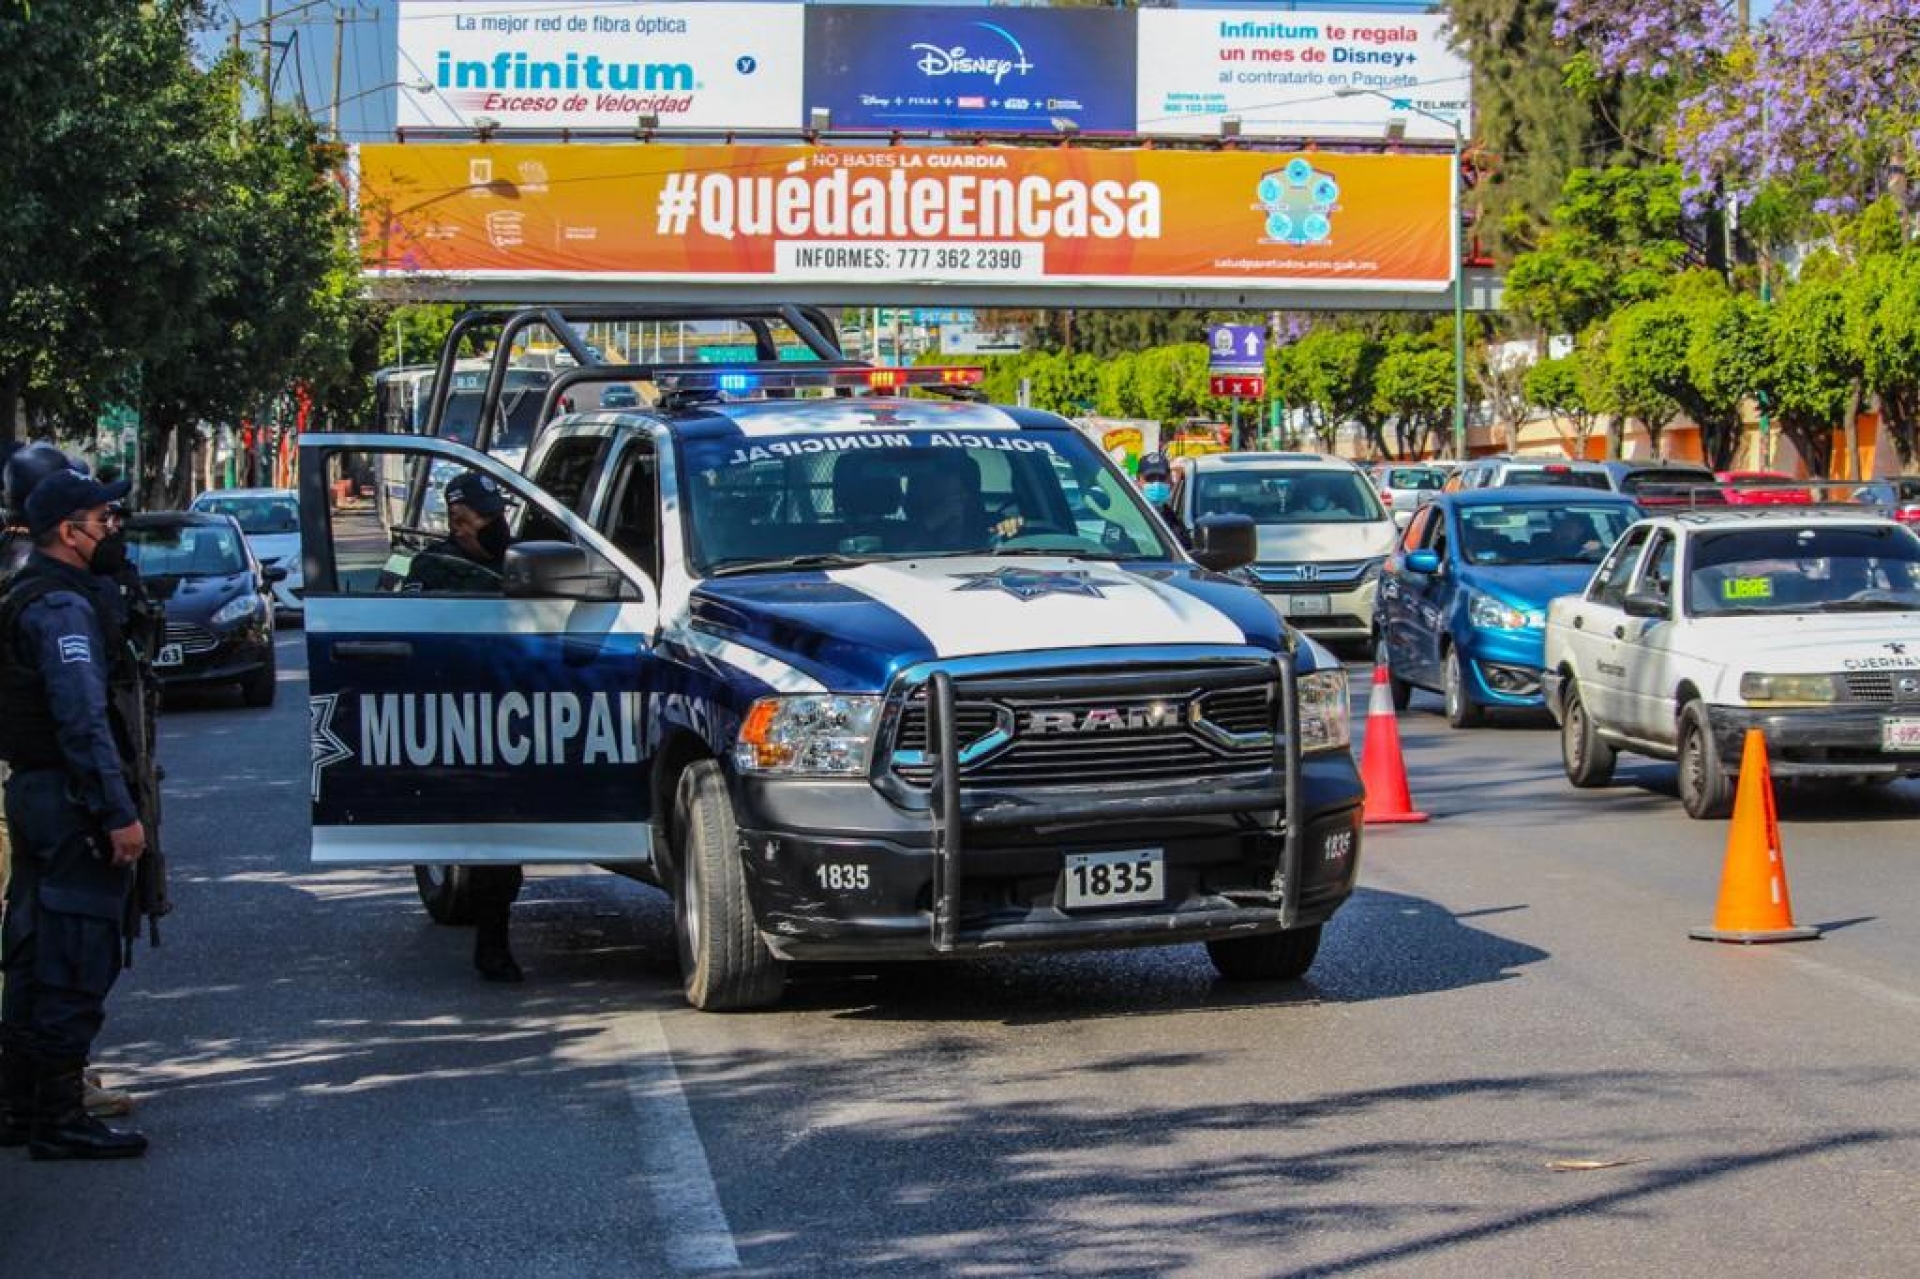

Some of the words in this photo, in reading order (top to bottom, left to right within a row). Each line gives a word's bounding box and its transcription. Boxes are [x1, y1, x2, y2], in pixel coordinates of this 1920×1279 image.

[456, 15, 476, 31] La
[482, 15, 528, 34] mejor
[535, 16, 561, 31] red
[567, 15, 587, 32] de
[593, 16, 630, 32] fibra
[635, 16, 687, 35] óptica
[1220, 21, 1319, 40] Infinitum
[1326, 25, 1346, 40] te
[1352, 26, 1418, 45] regala
[1220, 48, 1245, 61] un
[1252, 48, 1295, 62] mes
[1301, 47, 1327, 62] de
[1333, 47, 1417, 67] Disney+
[437, 50, 694, 91] infinitum
[1219, 70, 1233, 83] al
[1238, 70, 1323, 84] contratarlo
[1328, 74, 1347, 84] en
[1352, 71, 1418, 88] Paquete
[484, 93, 558, 111] Exceso
[563, 94, 588, 112] de
[595, 95, 692, 113] Velocidad
[1416, 100, 1468, 110] TELMEX
[812, 154, 839, 167] NO
[843, 154, 897, 168] BAJES
[900, 154, 923, 168] LA
[927, 155, 1007, 168] GUARDIA
[656, 158, 1161, 240] #QuédateEnCasa
[795, 247, 891, 269] INFORMES:
[897, 248, 931, 269] 777
[936, 248, 970, 269] 362
[976, 248, 1022, 270] 2390
[1214, 379, 1224, 393] 1
[1250, 379, 1260, 394] 1
[1724, 577, 1771, 599] LIBRE
[359, 691, 641, 766] MUNICIPAL
[1027, 703, 1180, 733] RAM
[1324, 831, 1351, 860] 1835
[816, 863, 870, 890] 1835
[1073, 861, 1154, 896] 1835
